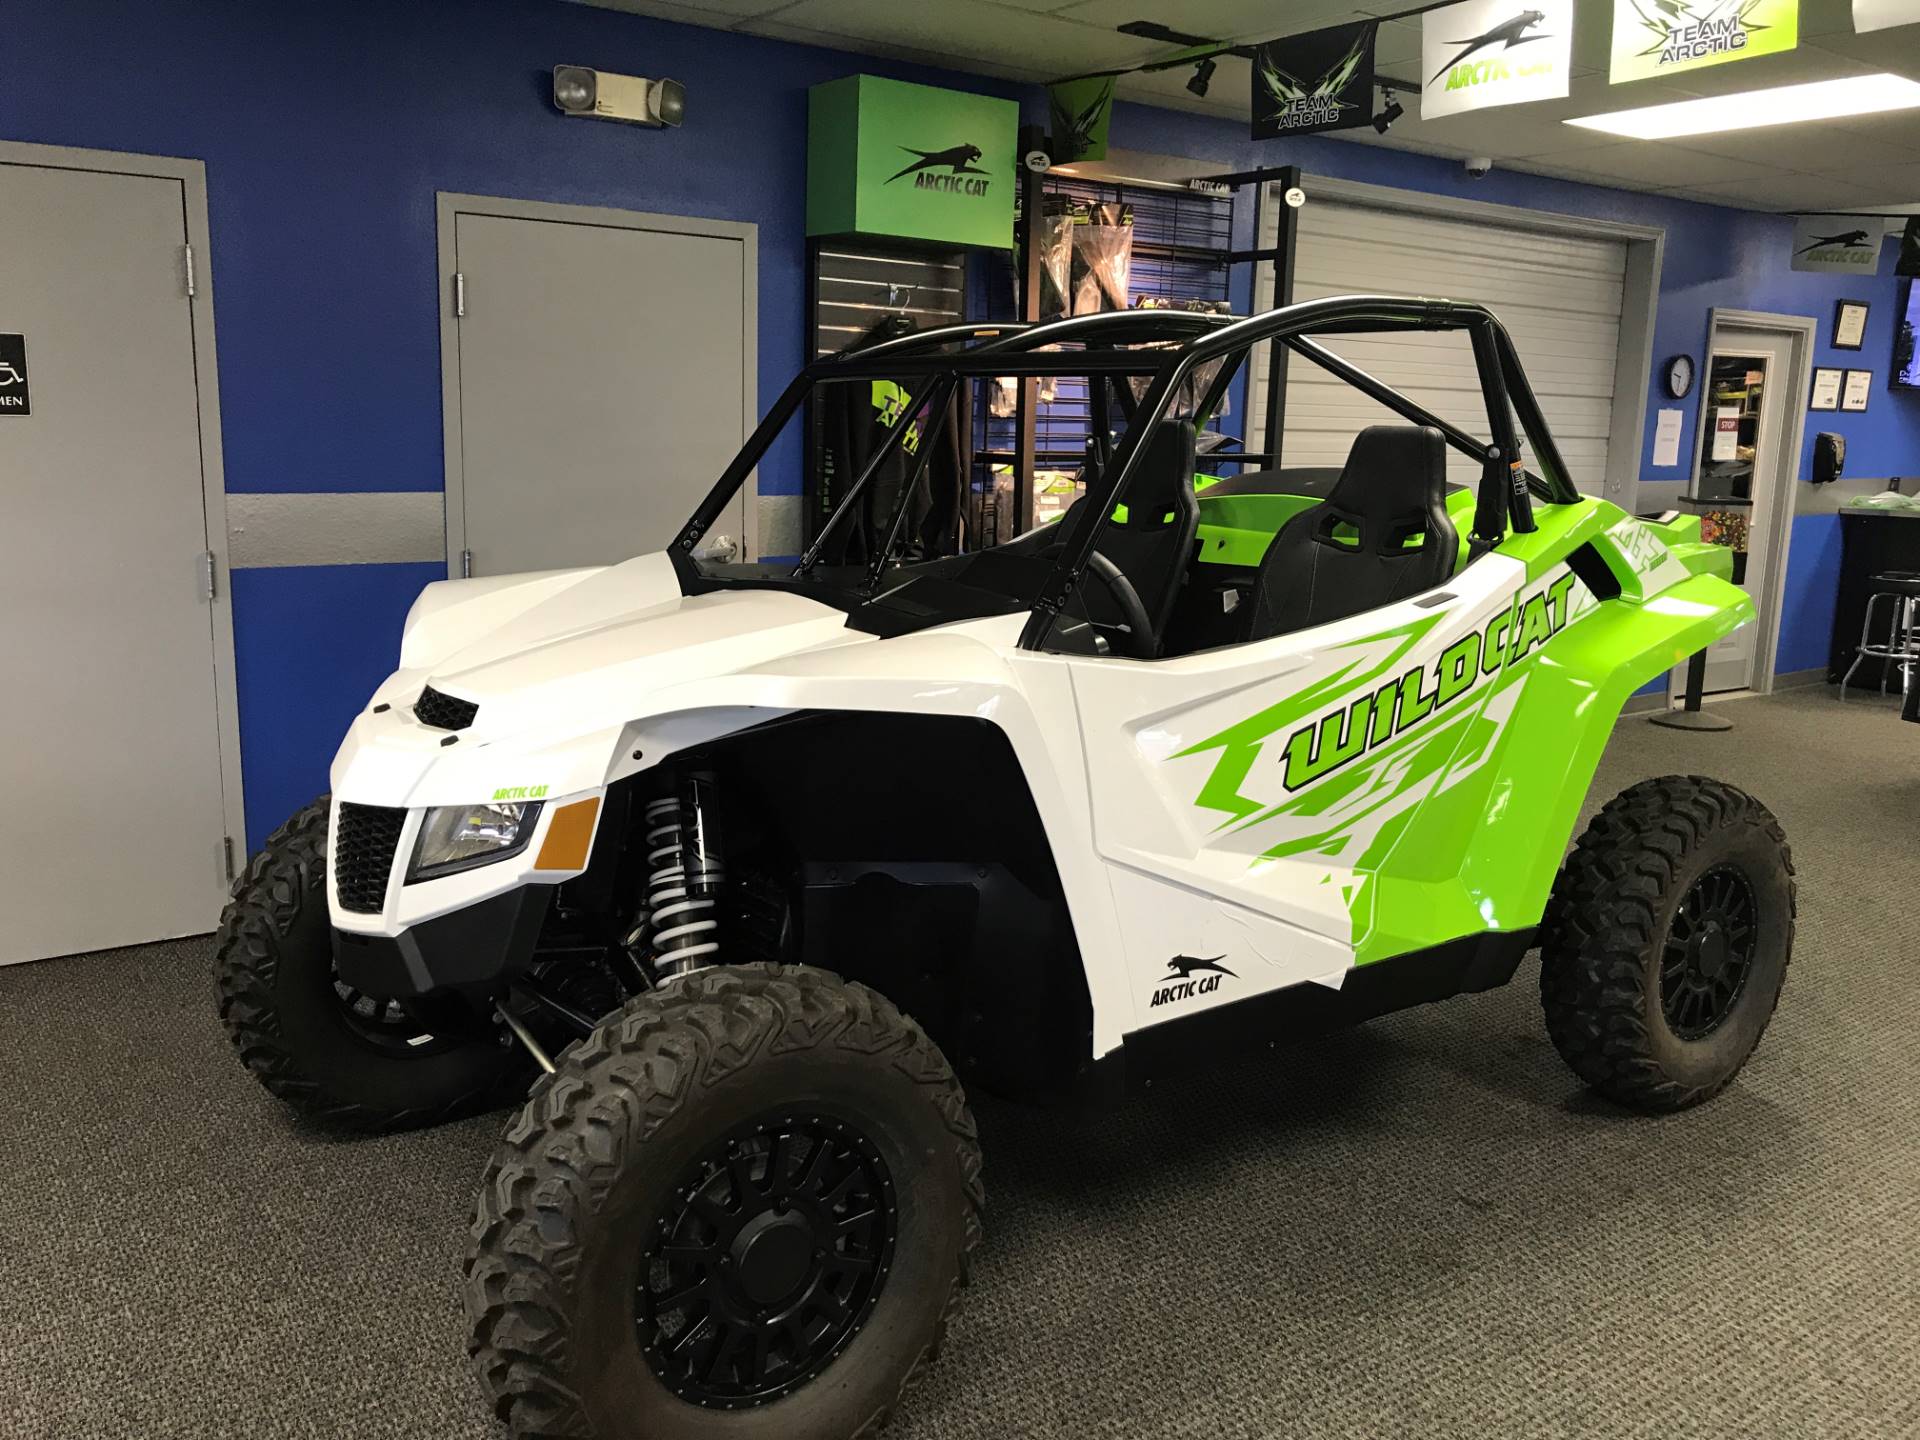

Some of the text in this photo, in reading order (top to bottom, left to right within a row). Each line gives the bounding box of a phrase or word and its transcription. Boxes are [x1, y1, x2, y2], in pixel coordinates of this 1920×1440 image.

[1667, 14, 1739, 45] TEAM
[1657, 31, 1747, 65] ARCTIC
[1285, 94, 1334, 112] TEAM
[1277, 108, 1340, 129] ARCTIC
[914, 171, 990, 197] ARCTIC CAT
[1721, 421, 1736, 429] STOP
[1279, 570, 1576, 793] WILDCAT
[492, 784, 549, 800] ARCTIC CAT
[1150, 974, 1222, 1008] ARCTIC CAT
